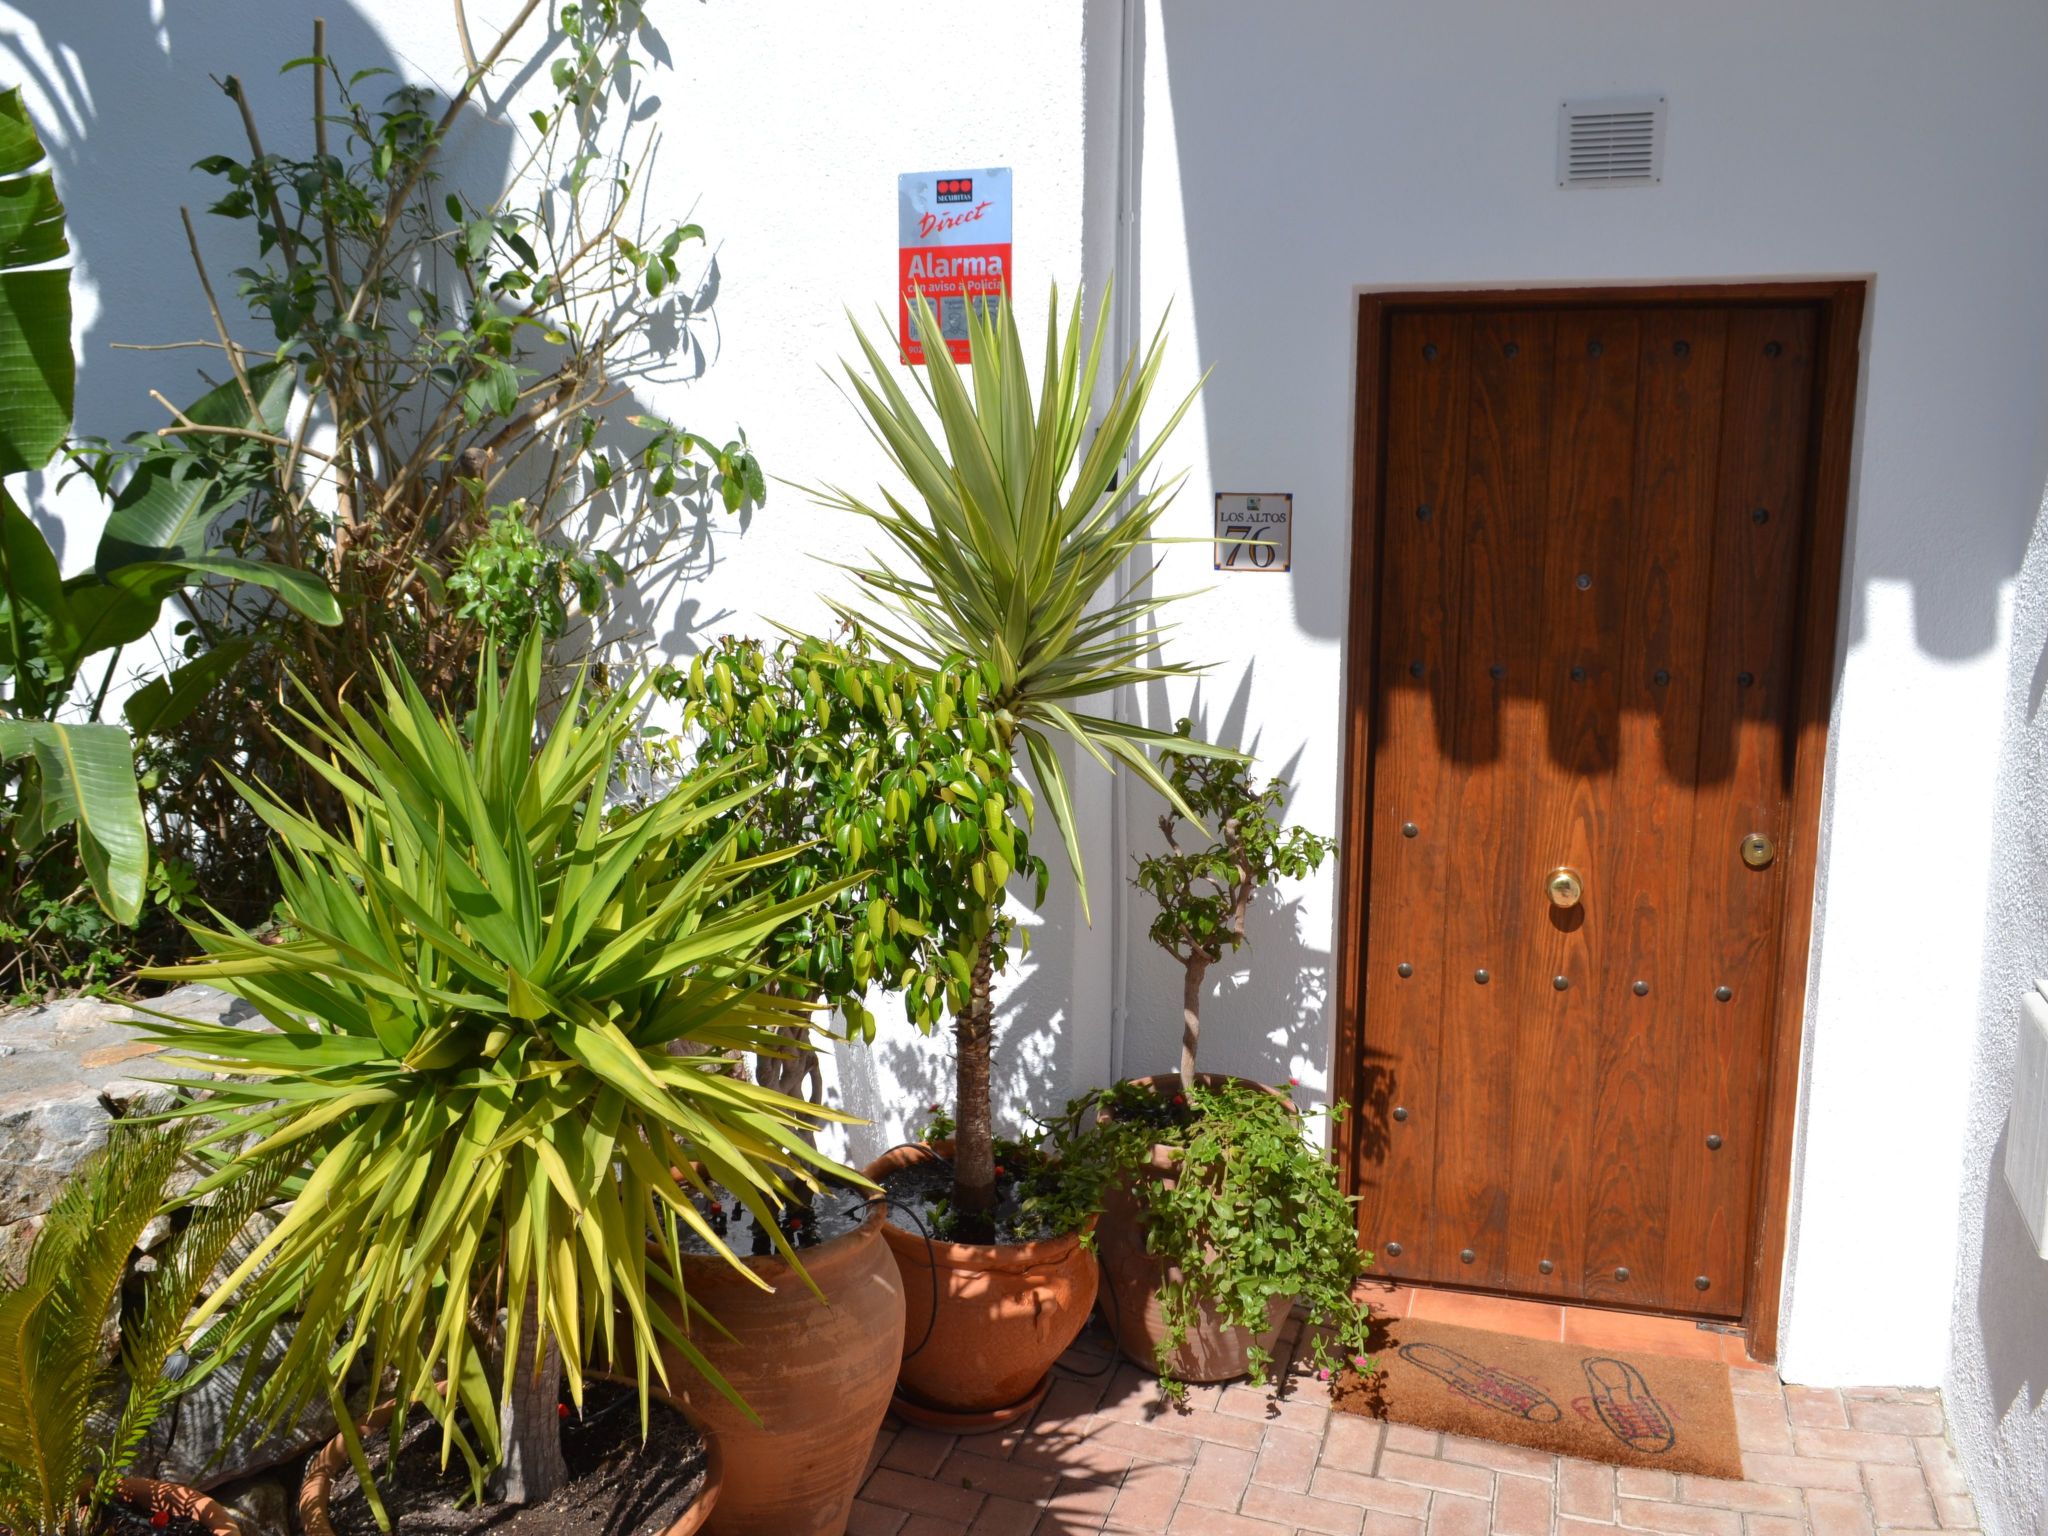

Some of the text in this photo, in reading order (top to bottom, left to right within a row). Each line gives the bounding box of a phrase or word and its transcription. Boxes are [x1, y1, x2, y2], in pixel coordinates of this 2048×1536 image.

[938, 194, 972, 203] SECURITAS
[918, 200, 995, 239] Direct
[907, 252, 1003, 280] Alarma
[929, 280, 956, 292] aviso
[1220, 512, 1286, 523] LOS ALTOS
[1225, 525, 1276, 568] 76
